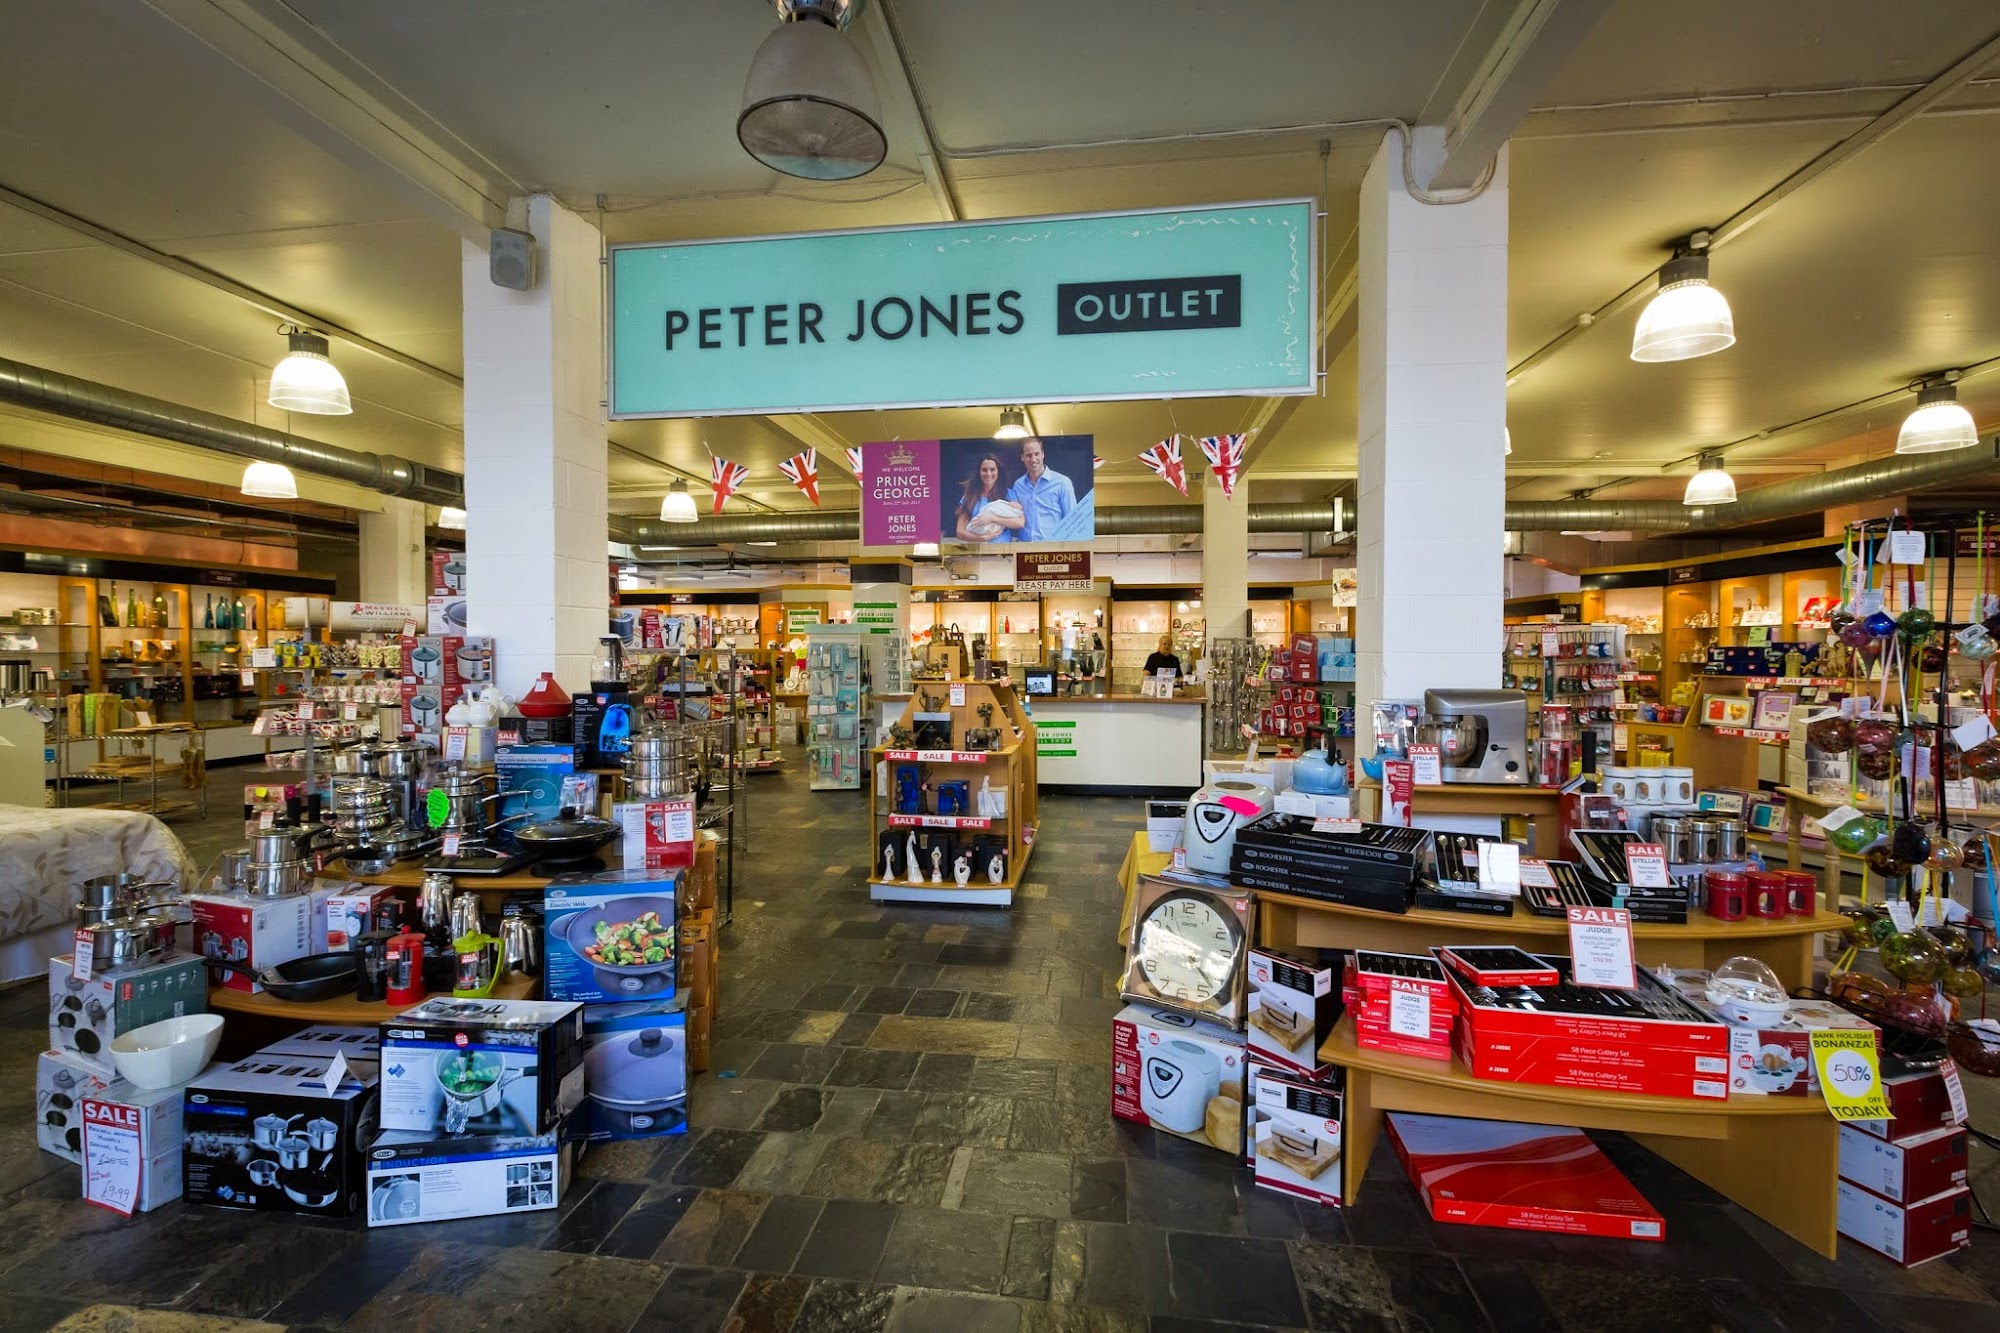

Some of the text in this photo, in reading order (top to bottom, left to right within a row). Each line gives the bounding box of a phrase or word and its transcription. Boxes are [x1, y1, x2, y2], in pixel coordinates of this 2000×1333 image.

[1075, 289, 1224, 322] OUTLET
[666, 290, 1024, 350] PETER JONES
[877, 475, 926, 487] PRINCE
[874, 487, 930, 499] GEORGE
[888, 515, 916, 523] PETER
[888, 524, 916, 532] JONES
[1024, 554, 1082, 563] PETER JONES
[665, 803, 692, 811] SALE
[1344, 848, 1382, 858] ROCHESTER
[1628, 847, 1662, 855] SALE
[1259, 852, 1293, 862] ROCHESTER
[1255, 864, 1289, 875] ROCHESTER
[1256, 880, 1289, 891] ROCHESTER
[1164, 905, 1174, 917] 11
[1182, 902, 1195, 914] 12
[1206, 911, 1210, 922] 1
[1570, 909, 1627, 924] SALE
[1216, 928, 1226, 940] 2
[1146, 960, 1156, 972] 8
[1160, 979, 1169, 990] 7
[1391, 980, 1430, 993] SALE
[1176, 988, 1188, 1000] 6
[1197, 985, 1209, 998] 5
[1400, 995, 1420, 1003] JUDGE
[1116, 1030, 1130, 1038] Digital
[1579, 1028, 1601, 1037] Cutlery
[398, 1041, 446, 1049] INDUCTION
[1597, 1049, 1619, 1058] Cutlery
[1940, 1060, 1955, 1073] SALE
[1595, 1071, 1617, 1081] Cutlery
[1834, 1064, 1871, 1082] 50%
[85, 1103, 138, 1126] SALE
[1832, 1107, 1887, 1118] TODAY!
[382, 1157, 446, 1168] INDUCTION
[1545, 1214, 1564, 1222] Cutlery
